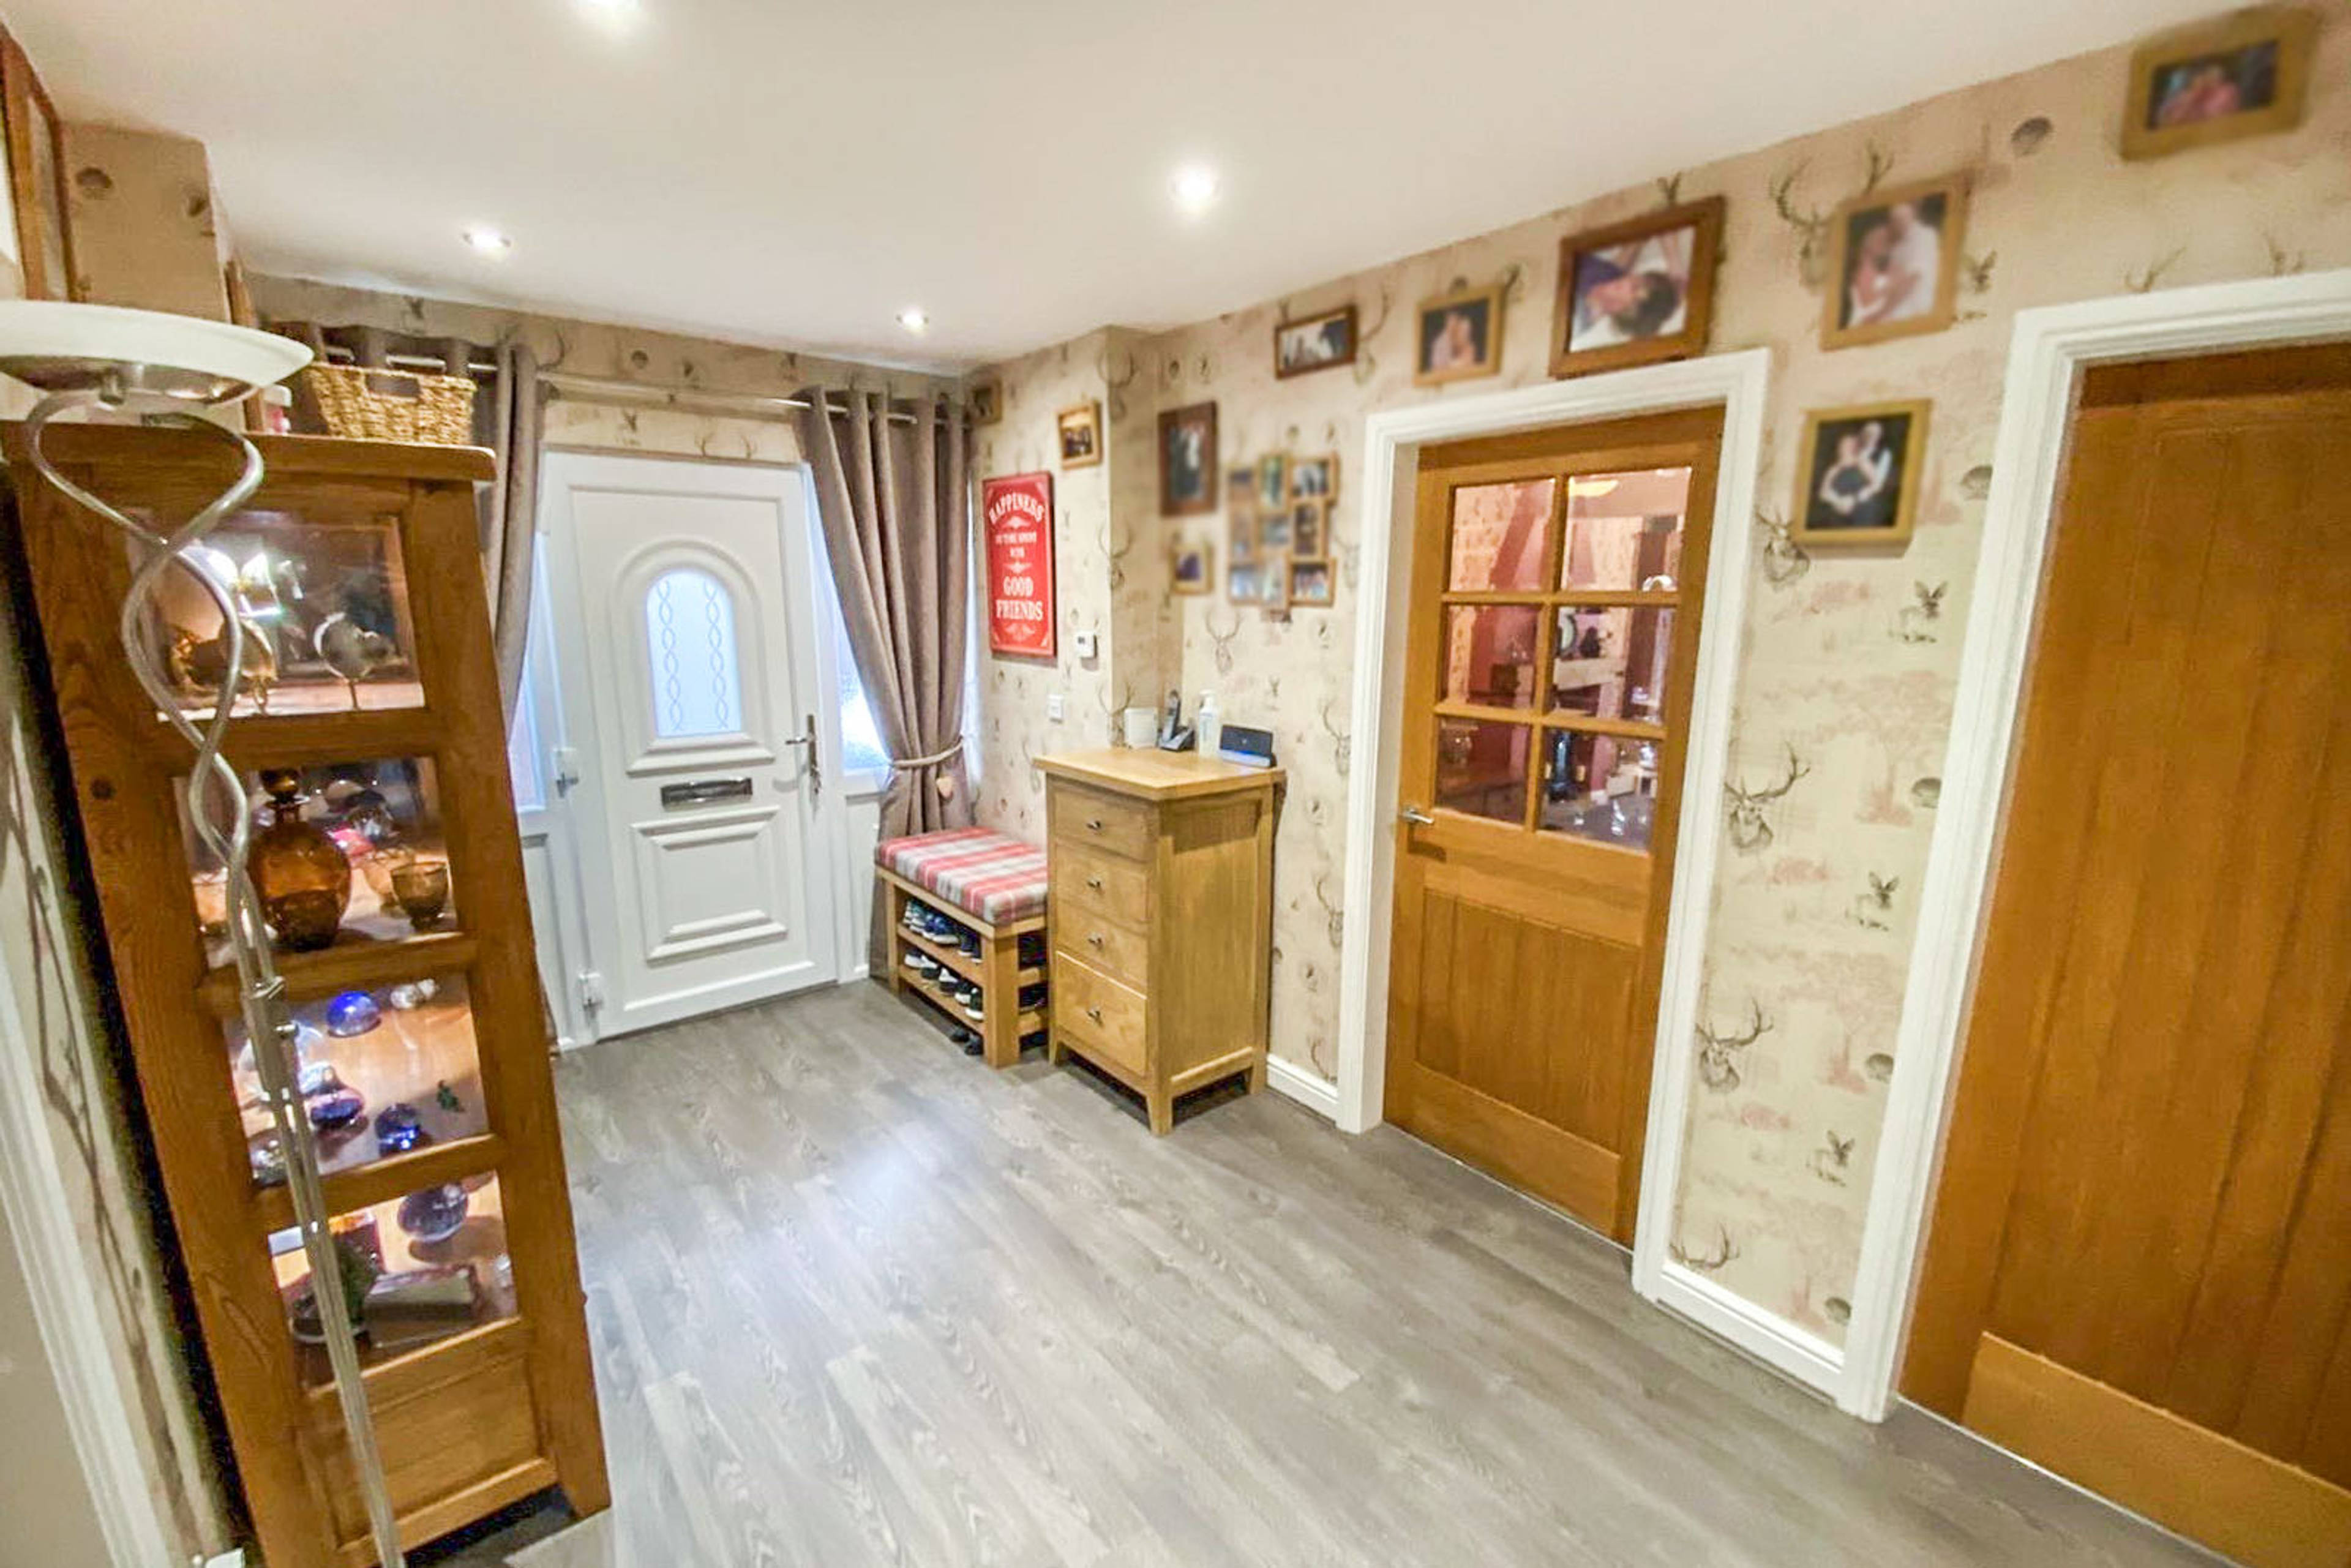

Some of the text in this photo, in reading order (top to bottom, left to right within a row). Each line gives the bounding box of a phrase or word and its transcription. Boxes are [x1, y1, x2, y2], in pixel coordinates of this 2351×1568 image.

[989, 493, 1044, 524] HAPPINESS
[1003, 577, 1034, 596] GOOD
[996, 599, 1043, 621] FRIENDS
